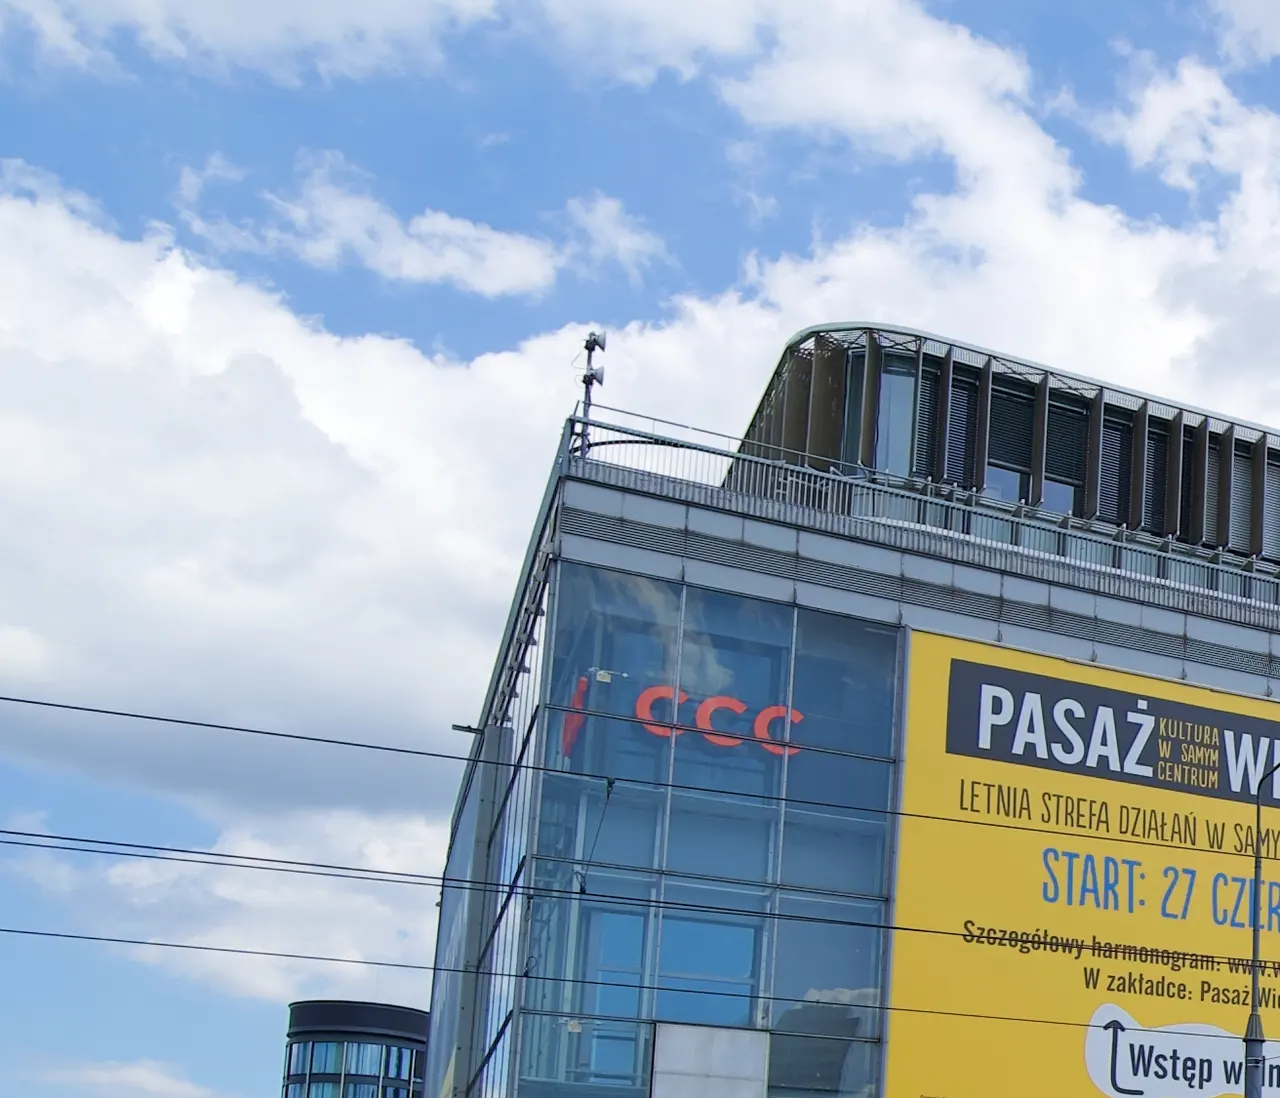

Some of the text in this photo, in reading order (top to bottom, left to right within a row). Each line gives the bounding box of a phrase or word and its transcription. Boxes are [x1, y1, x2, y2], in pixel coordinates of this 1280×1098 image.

[635, 686, 804, 756] CCC
[978, 684, 1155, 777] PASAŻ
[1159, 717, 1220, 746] KULTURA
[1158, 739, 1219, 767] W SAMYM
[1158, 762, 1219, 789] CENTRUM
[960, 779, 1032, 820] LETNIA
[1041, 792, 1110, 833] STREFA
[1119, 805, 1197, 846] DZIAŁAŃ
[1206, 819, 1226, 850] W
[1042, 848, 1146, 914] START:
[1161, 865, 1197, 921] 27
[962, 920, 1085, 960] Szczegółowy
[1083, 967, 1101, 989] W
[1106, 971, 1193, 1000] zakładce:
[1200, 980, 1250, 1006] Pasaż
[1129, 1043, 1213, 1090] Wstęp
